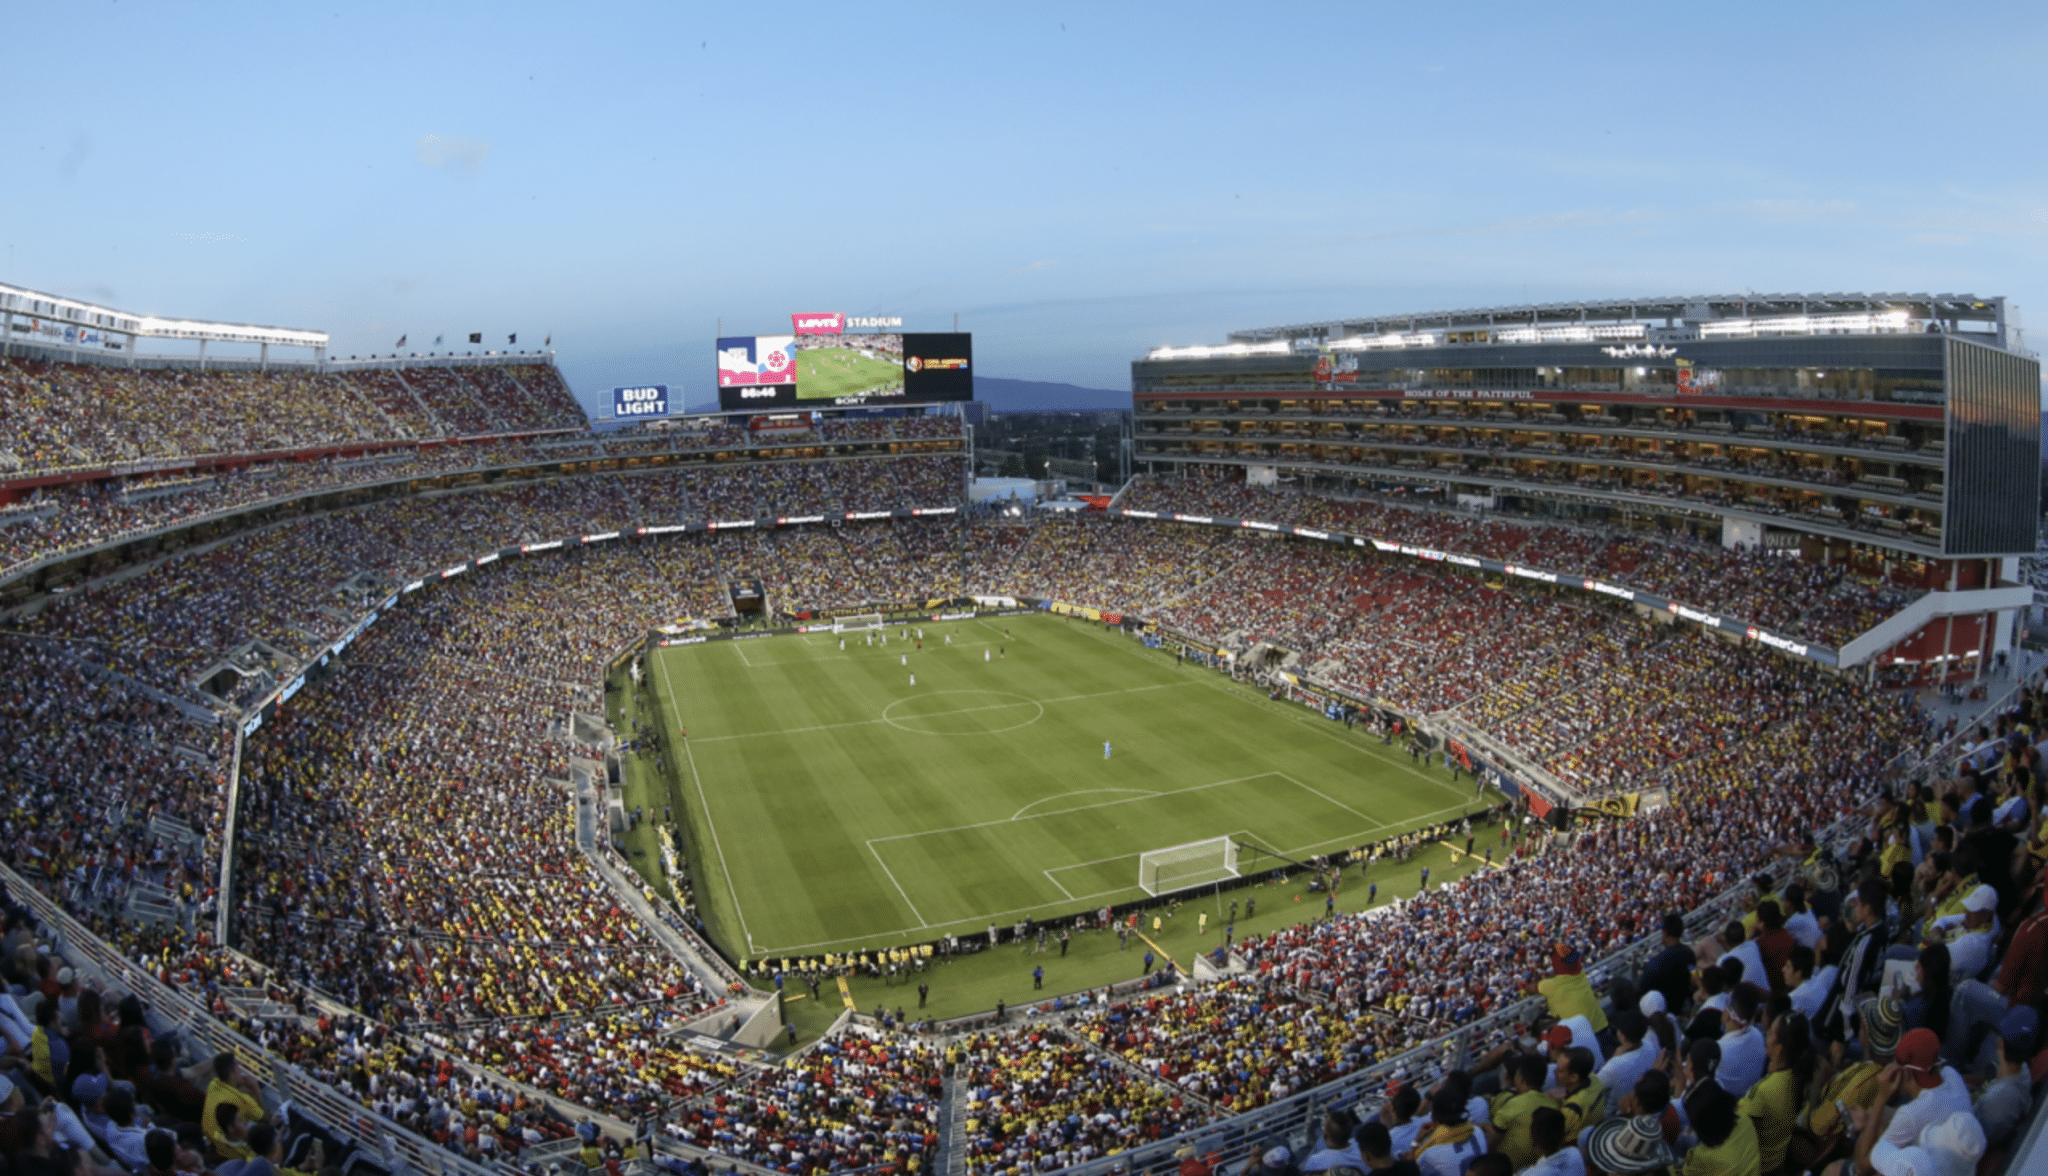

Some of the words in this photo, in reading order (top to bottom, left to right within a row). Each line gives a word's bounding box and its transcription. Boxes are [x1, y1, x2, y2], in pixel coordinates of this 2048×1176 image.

[846, 316, 902, 328] STADIUM
[622, 387, 659, 402] BUD
[835, 396, 867, 405] SONY
[1404, 389, 1434, 398] HOME
[1435, 390, 1450, 398] OF
[1452, 390, 1475, 399] THE
[1477, 390, 1535, 399] FAITHFUL
[616, 400, 666, 416] LIGHT
[1514, 566, 1558, 583] MasterCard
[1594, 581, 1635, 601] MasterCard
[1677, 605, 1721, 628] MasterCard
[1758, 630, 1808, 657] MasterCard
